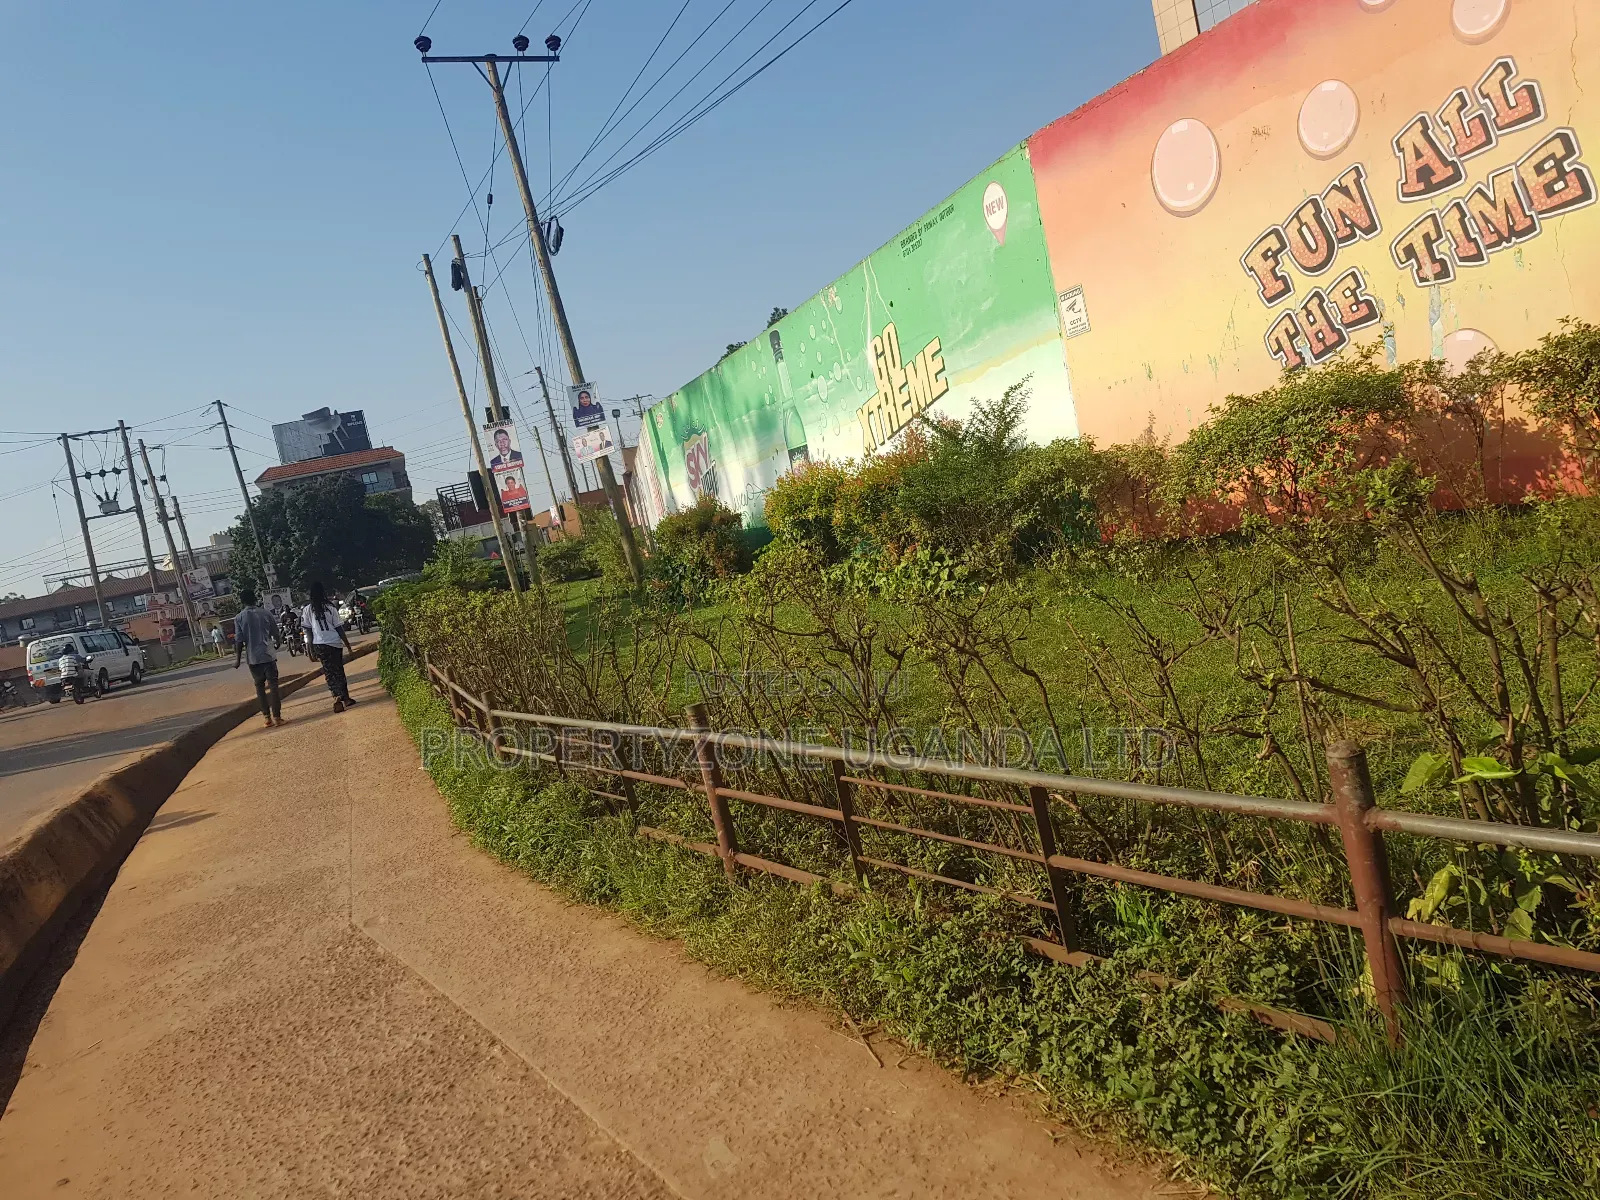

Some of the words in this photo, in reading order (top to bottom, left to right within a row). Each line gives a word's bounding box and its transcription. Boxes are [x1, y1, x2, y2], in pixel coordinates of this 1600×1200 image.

[985, 195, 1004, 218] NEW
[1240, 162, 1383, 308] FUN
[1391, 55, 1548, 203] ALL
[1264, 266, 1383, 372] THE
[1390, 127, 1598, 287] TIME
[870, 321, 902, 388] GO
[1069, 316, 1082, 326] CCTV
[856, 335, 949, 458] XTREME
